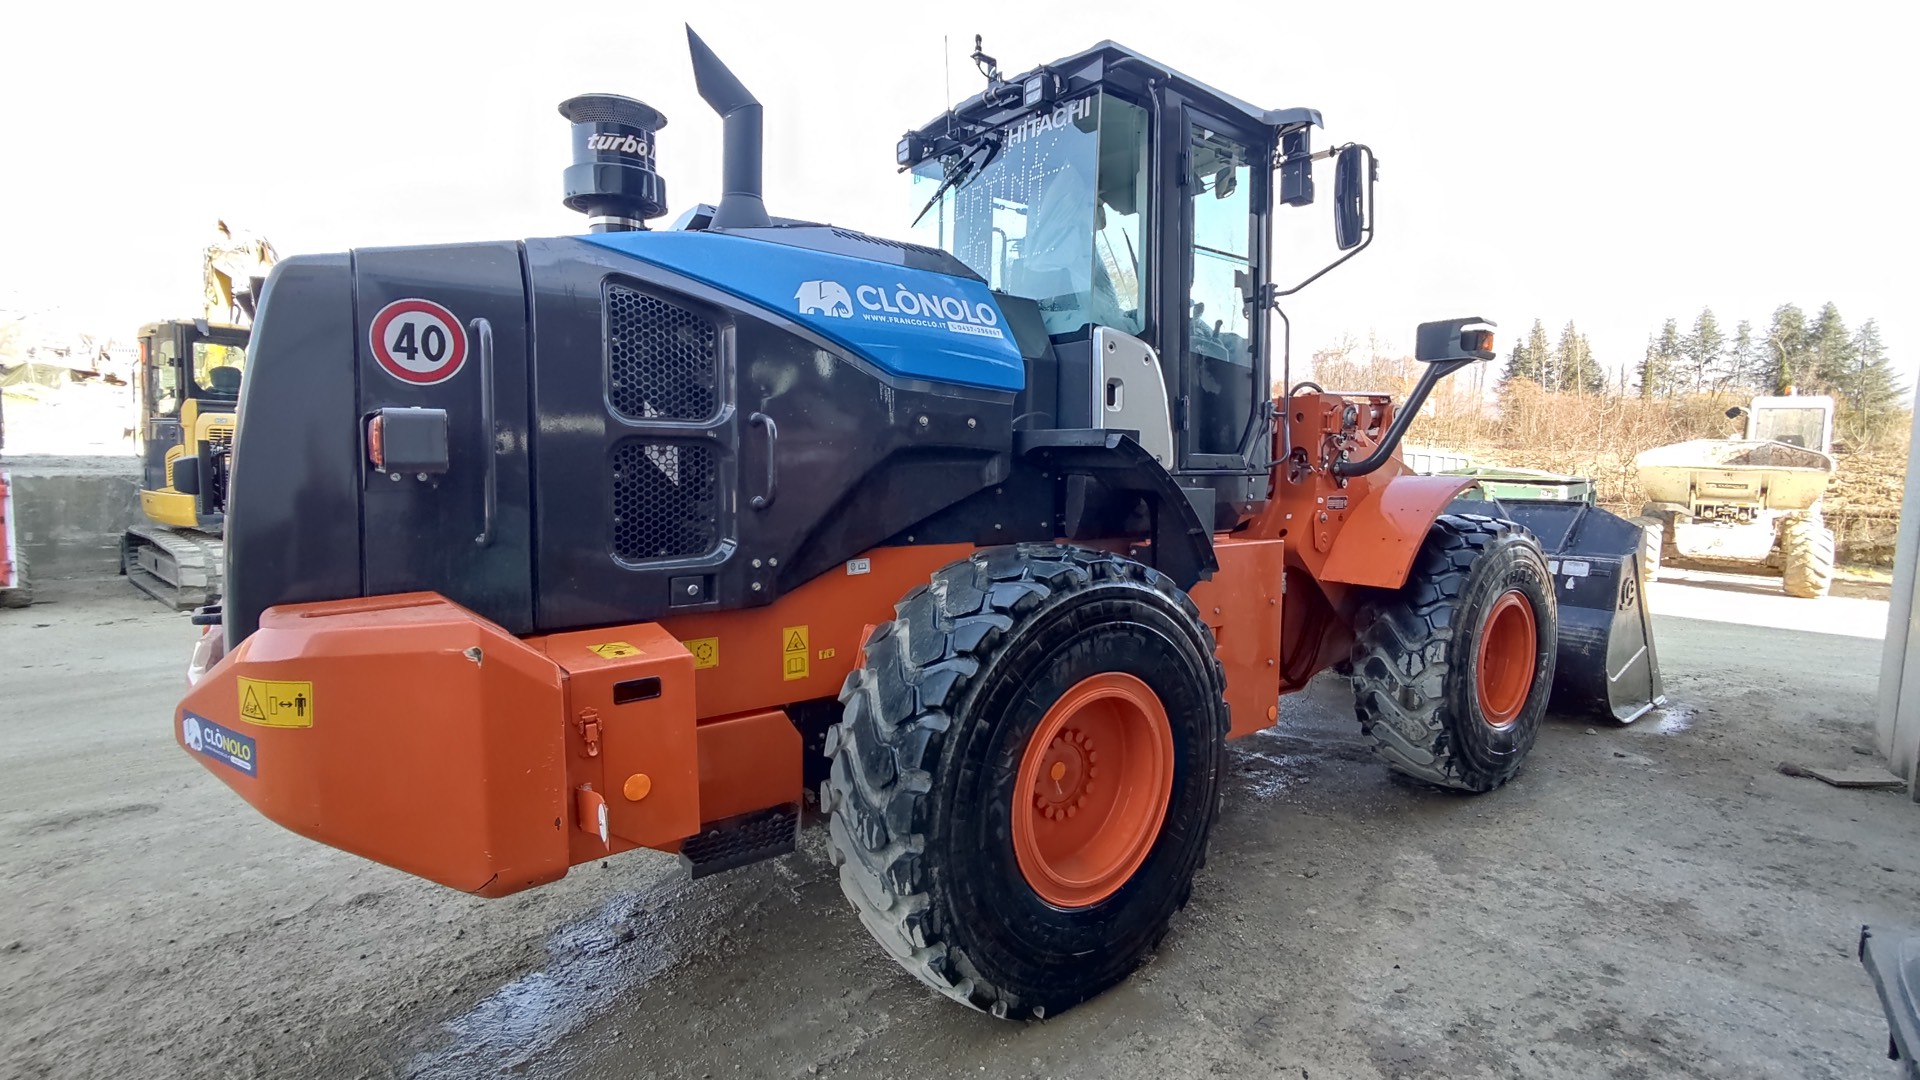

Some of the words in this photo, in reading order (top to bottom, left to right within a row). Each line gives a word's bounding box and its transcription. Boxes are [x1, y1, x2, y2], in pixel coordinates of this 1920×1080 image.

[1008, 96, 1091, 148] HITACHI
[856, 283, 998, 326] CLÒNOLO
[863, 314, 947, 329] WWW.FRANCOCLO.IT
[392, 322, 446, 362] 40
[204, 728, 251, 761] CLÒNOLO
